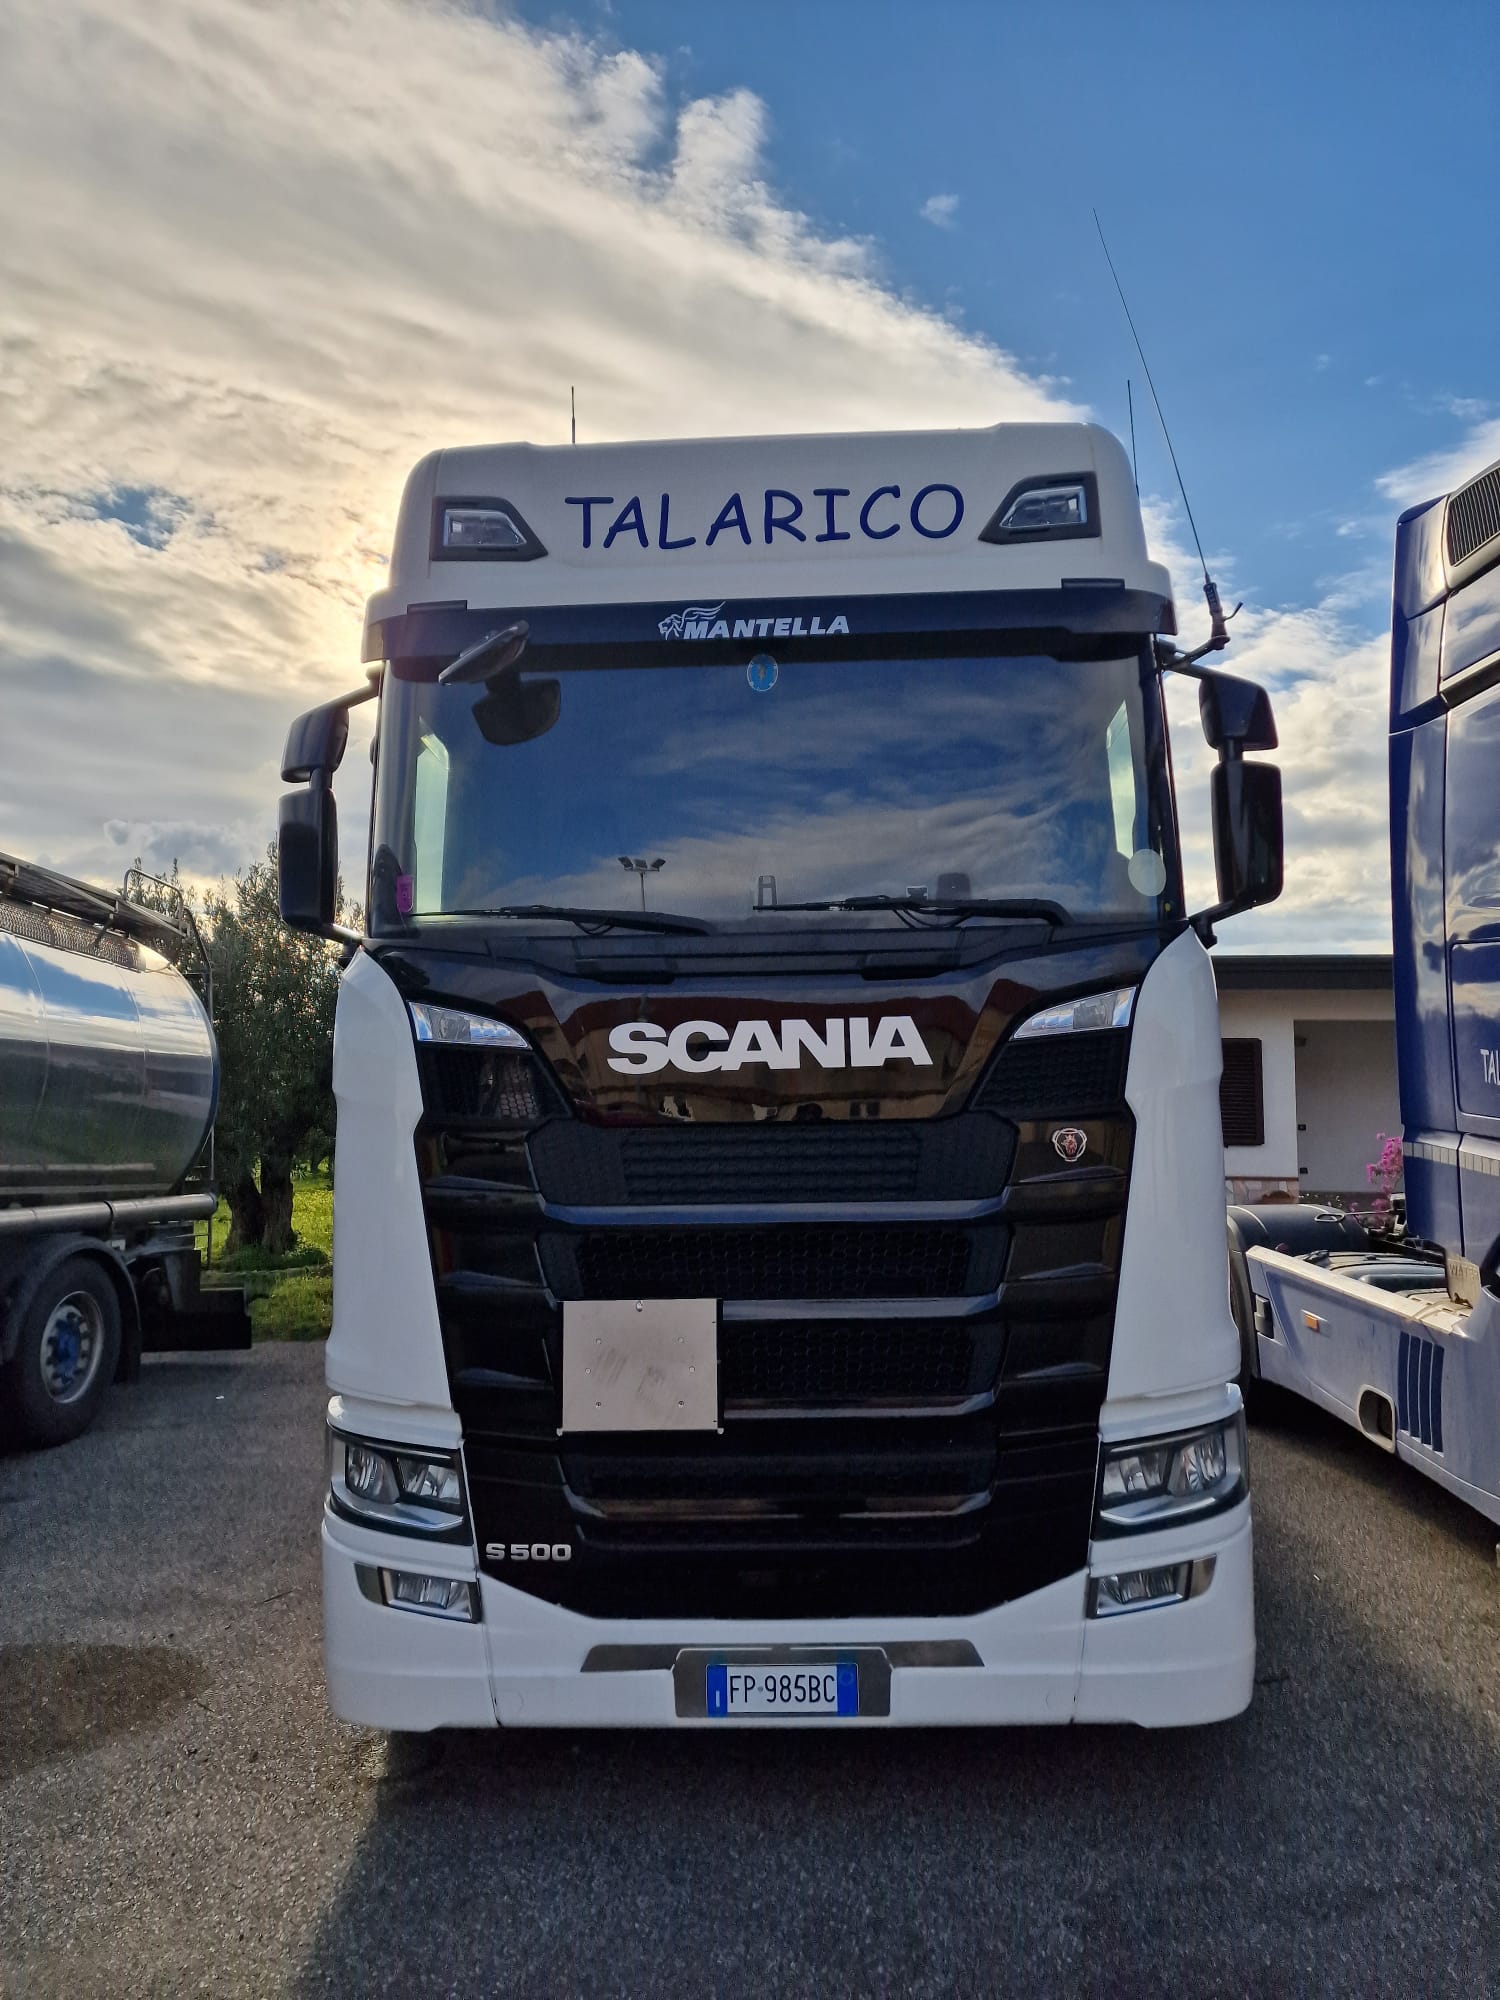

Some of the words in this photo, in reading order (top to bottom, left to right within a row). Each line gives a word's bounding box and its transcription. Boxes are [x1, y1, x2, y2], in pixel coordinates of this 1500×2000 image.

[564, 483, 965, 550] TALARICO
[684, 615, 850, 640] MANTELLA
[606, 1015, 933, 1075] SCANIA
